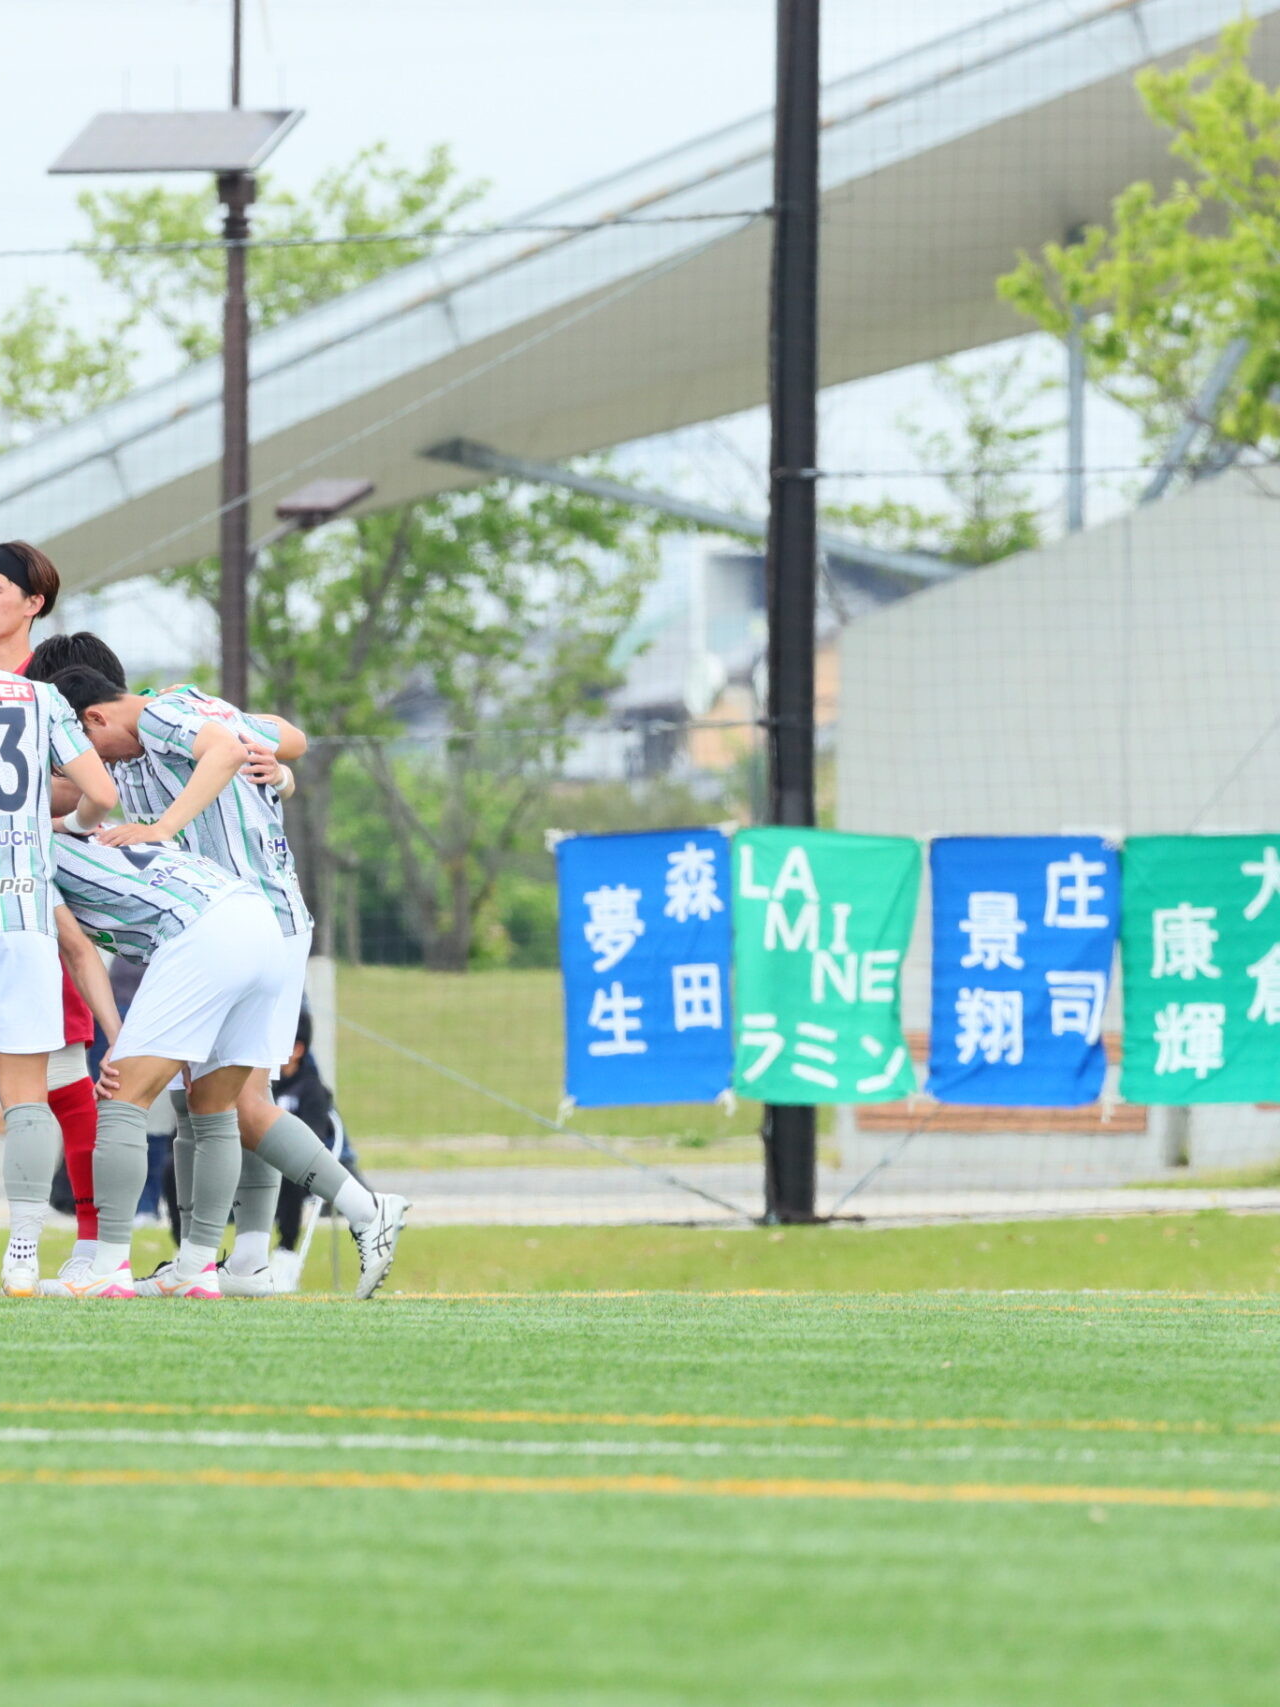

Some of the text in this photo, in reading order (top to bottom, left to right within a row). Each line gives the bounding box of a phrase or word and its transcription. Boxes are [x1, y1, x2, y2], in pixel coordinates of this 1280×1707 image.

[664, 842, 724, 1032] 森田
[739, 844, 819, 900] LA
[764, 901, 852, 954] MI
[1044, 853, 1110, 1045] 庄司
[583, 884, 648, 1056] 夢生
[740, 1013, 907, 1093] ラミン
[810, 949, 901, 1004] NE
[954, 891, 1027, 1065] 景翔
[1150, 902, 1226, 1079] 康輝
